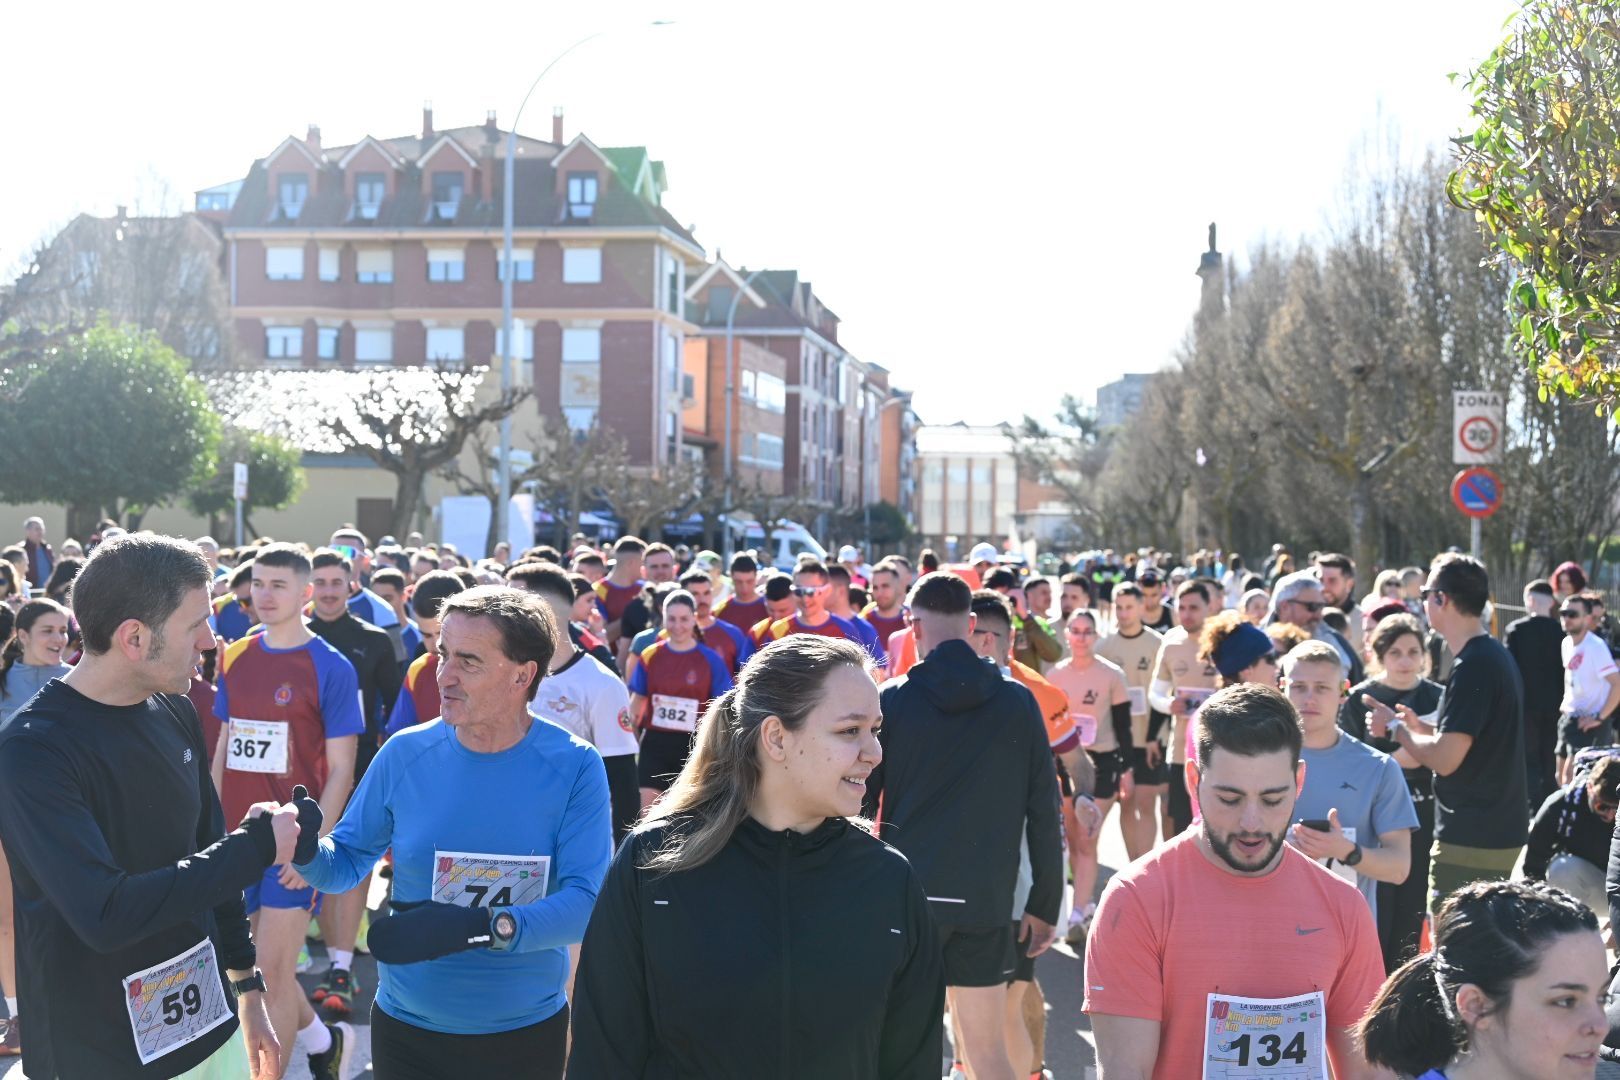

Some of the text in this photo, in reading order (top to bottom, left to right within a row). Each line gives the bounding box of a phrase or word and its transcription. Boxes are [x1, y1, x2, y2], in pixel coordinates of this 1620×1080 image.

[1457, 395, 1500, 407] ZONA
[658, 707, 687, 722] 382
[233, 738, 272, 759] 367
[465, 884, 514, 909] 74
[162, 983, 202, 1026] 59
[1210, 1000, 1230, 1019] 10
[1255, 1014, 1284, 1027] Virgen
[1215, 1019, 1226, 1034] 5
[1230, 1031, 1308, 1067] 134
